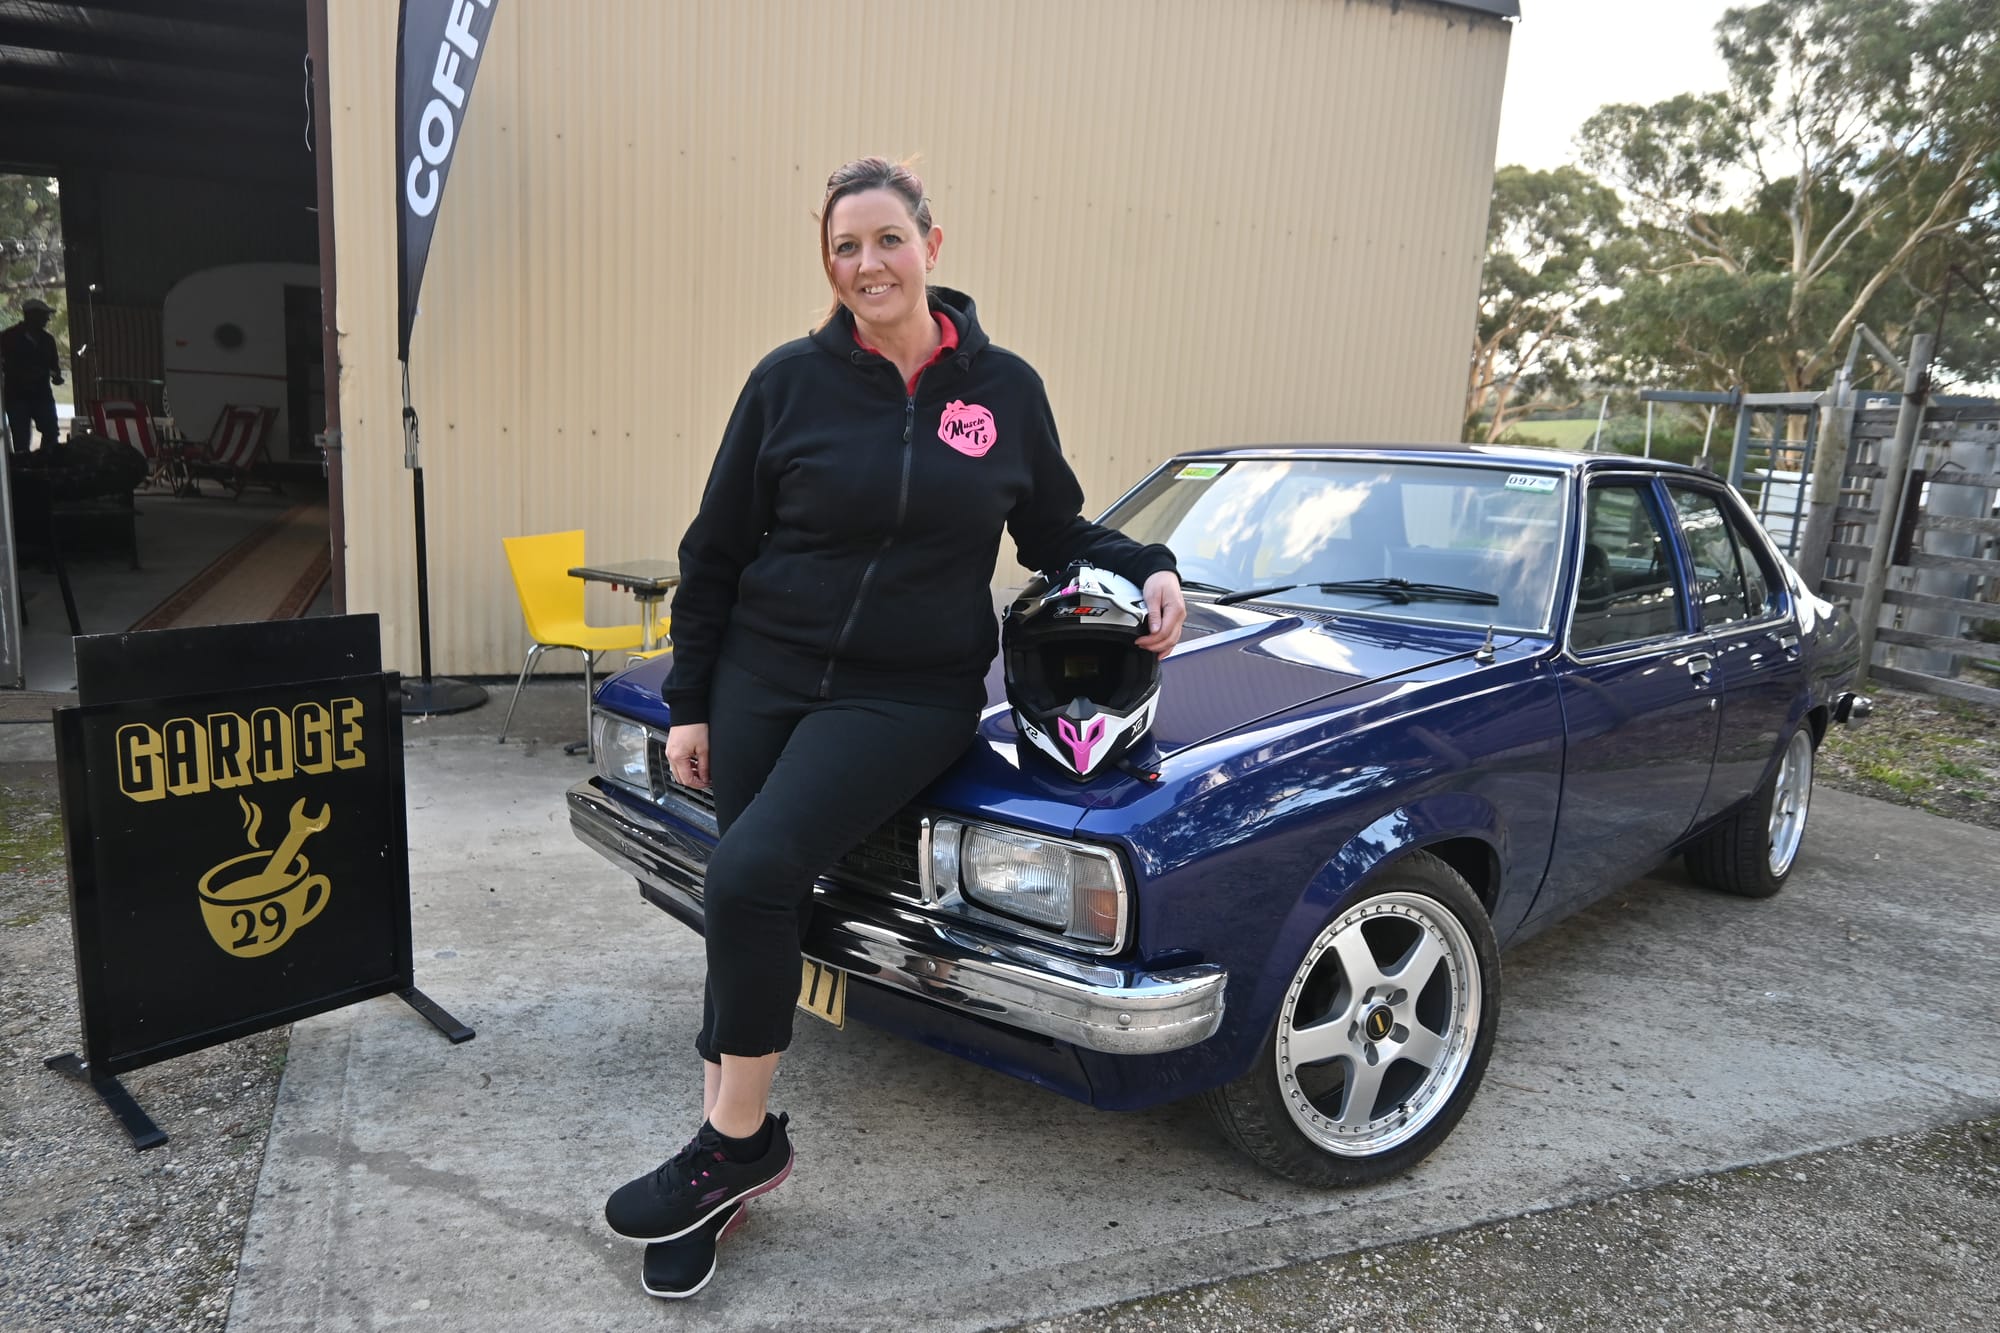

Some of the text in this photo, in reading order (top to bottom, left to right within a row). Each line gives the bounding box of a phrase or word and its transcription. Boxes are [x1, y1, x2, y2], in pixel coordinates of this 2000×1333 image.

[407, 0, 491, 217] COFF
[1508, 476, 1537, 486] 097
[116, 697, 366, 802] GARAGE
[231, 901, 287, 950] 29
